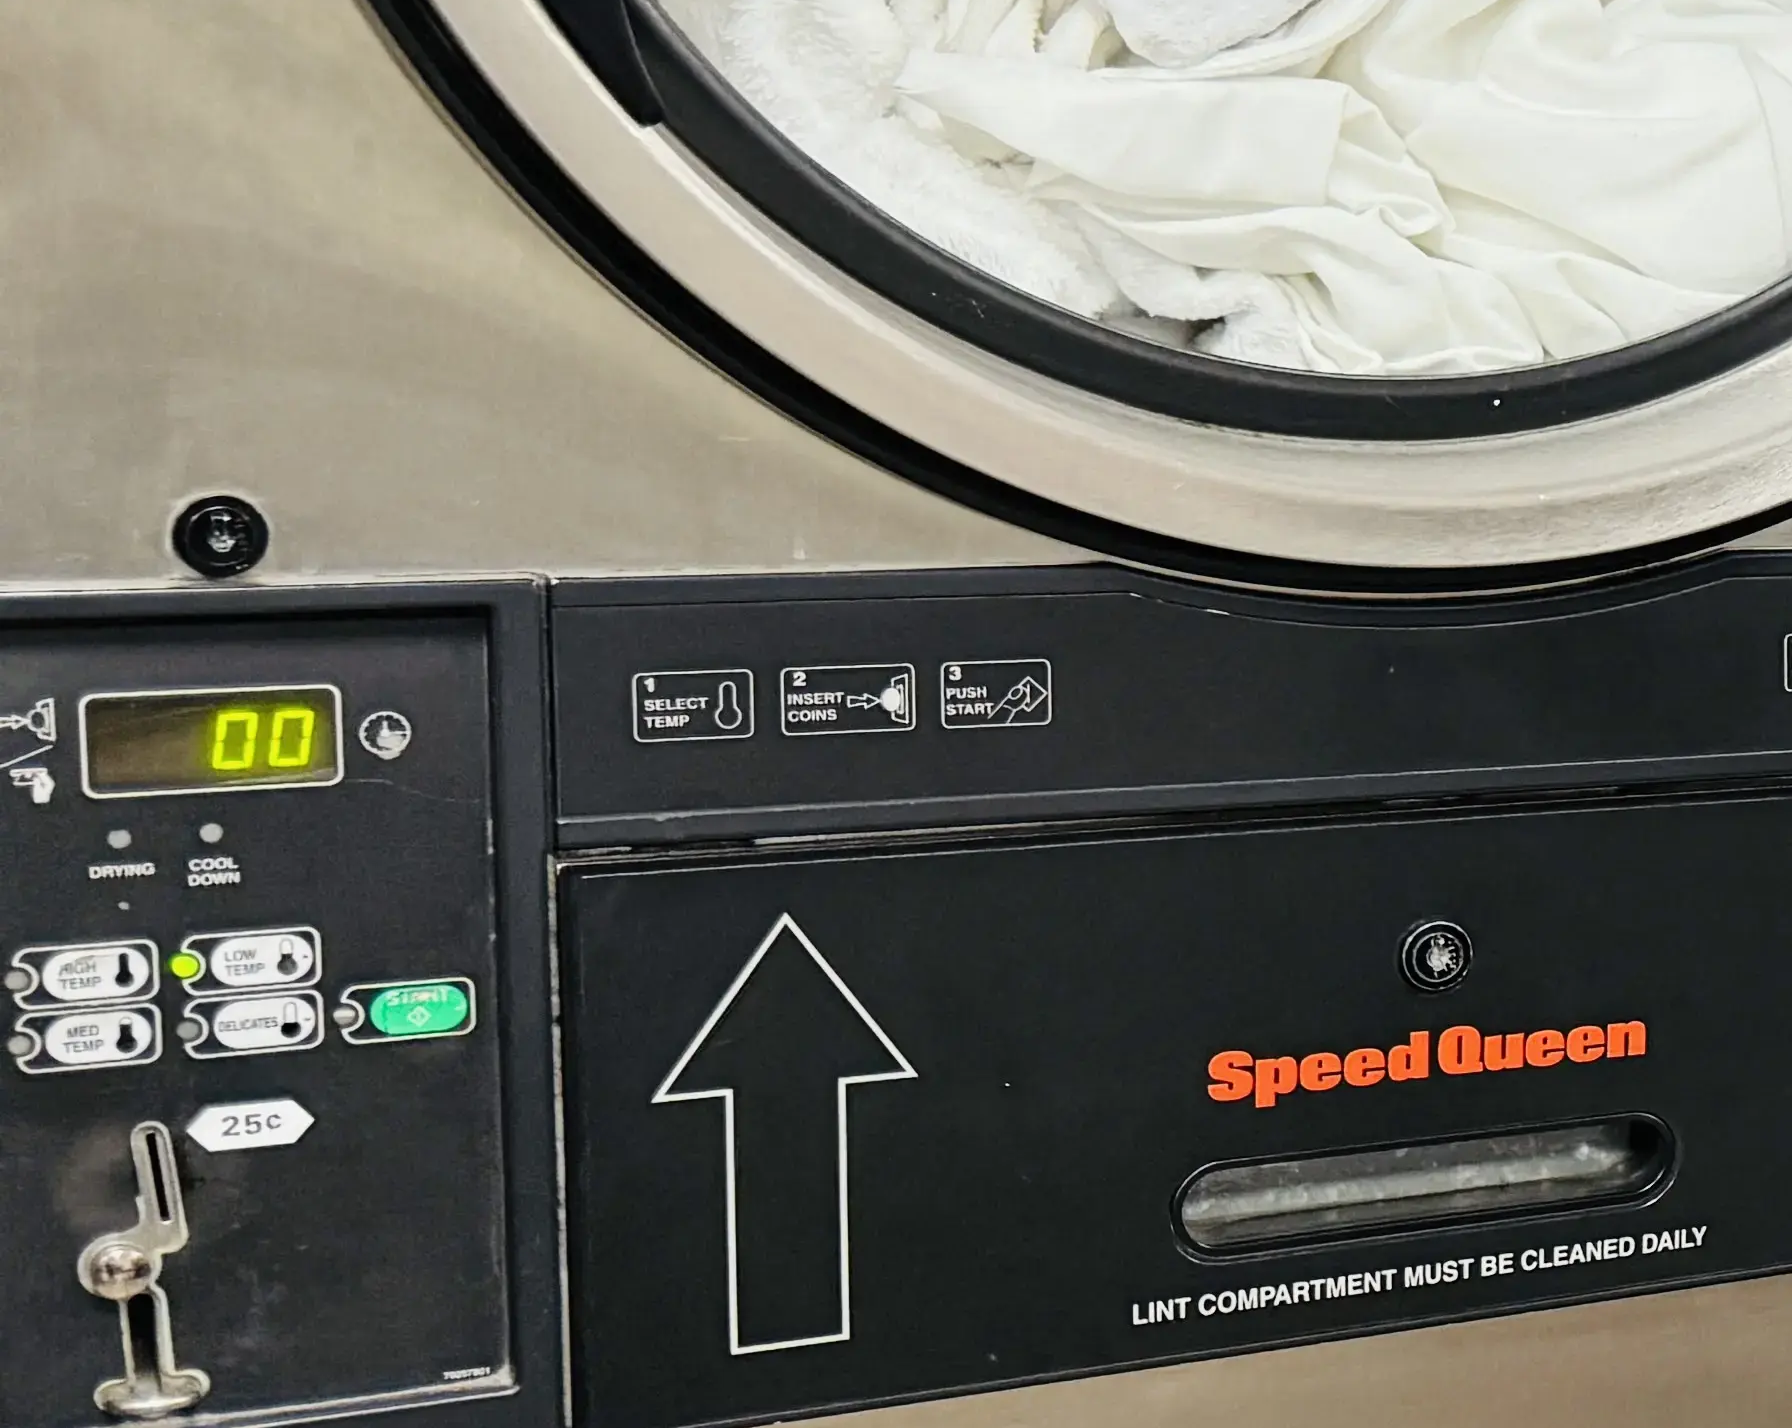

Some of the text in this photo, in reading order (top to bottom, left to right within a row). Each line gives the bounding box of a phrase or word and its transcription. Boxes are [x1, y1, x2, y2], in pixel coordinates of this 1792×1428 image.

[793, 672, 807, 687] 2
[948, 666, 962, 681] 3
[643, 677, 656, 692] 1
[946, 685, 988, 700] PUSH
[643, 696, 708, 712] SELECT
[786, 691, 844, 706] INSERT
[788, 708, 838, 723] COINS
[946, 701, 993, 717] START
[644, 713, 690, 729] TEMP
[212, 709, 315, 770] 00
[88, 861, 156, 880] DRYING
[188, 857, 240, 873] COOL
[187, 871, 241, 887] DOWN
[224, 948, 257, 963] LOW
[225, 961, 266, 977] TEMP
[57, 974, 102, 991] TEMP
[385, 989, 449, 1007] START
[67, 1024, 99, 1039] MED
[218, 1016, 279, 1033] DELICATES
[63, 1038, 105, 1055] TEMP
[1207, 1020, 1647, 1108] Speed Queen
[1132, 1225, 1708, 1326] LINT COMPARTMENT MUST BE CLEANED DAILY
